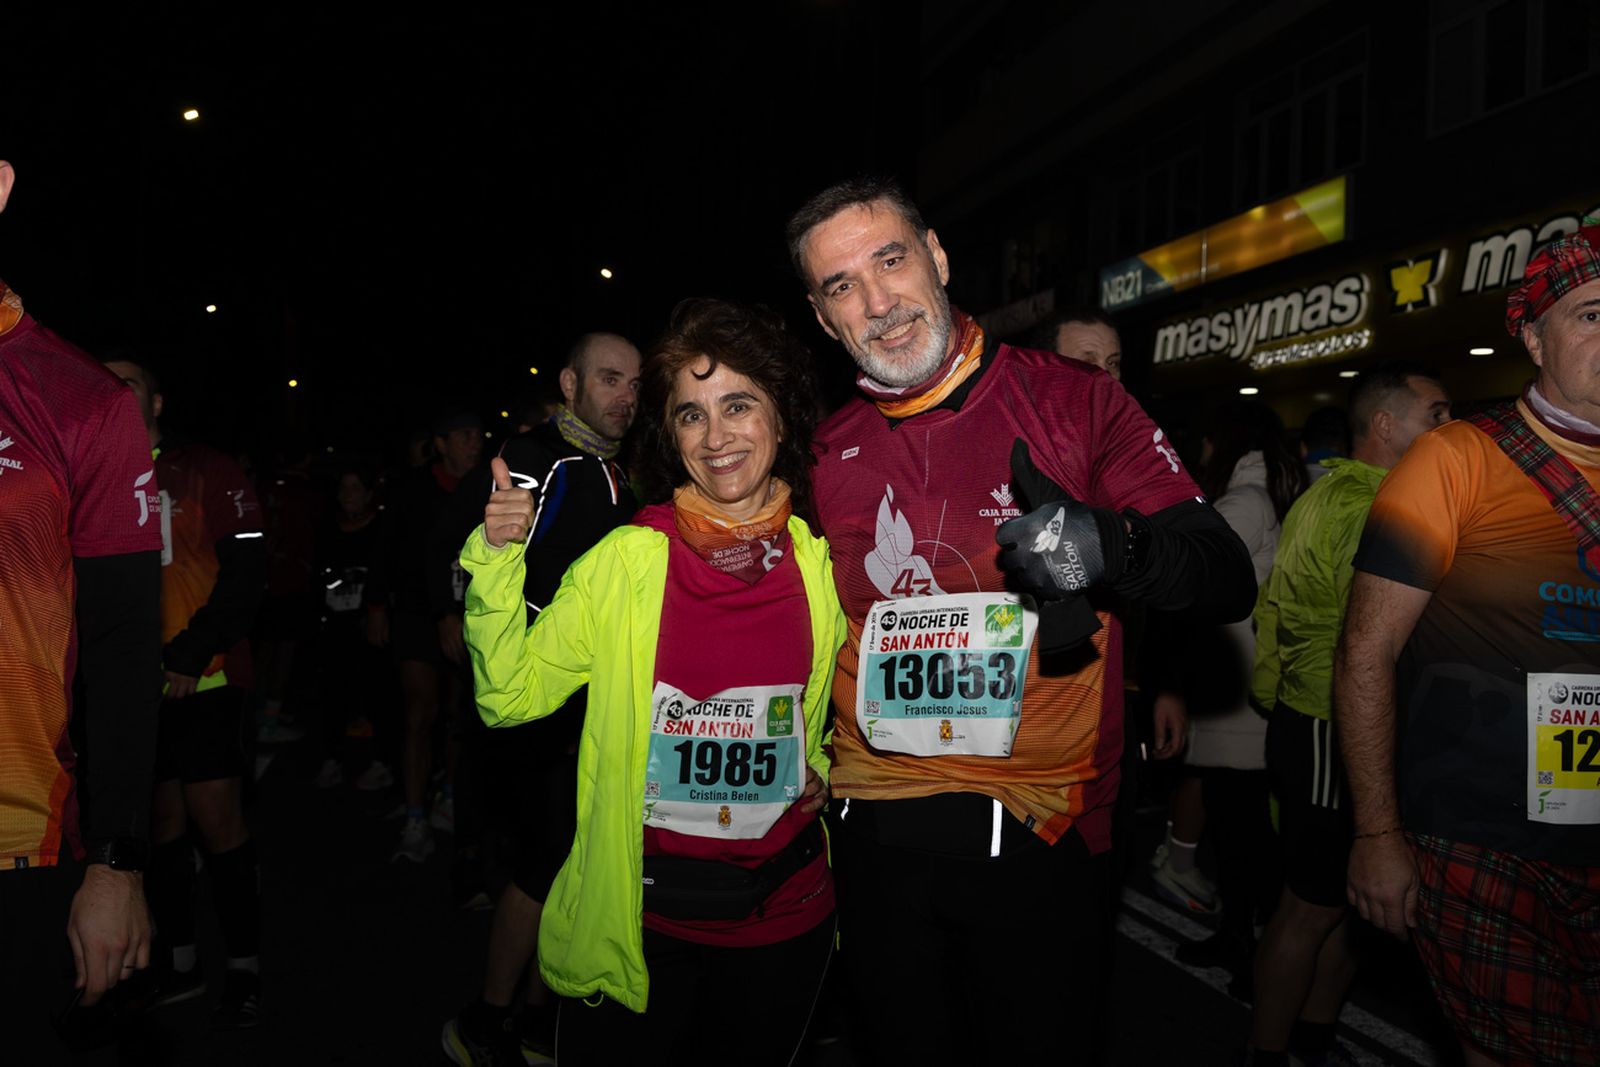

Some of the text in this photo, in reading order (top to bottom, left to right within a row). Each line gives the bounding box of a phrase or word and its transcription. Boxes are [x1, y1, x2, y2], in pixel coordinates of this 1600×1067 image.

[1102, 269, 1143, 308] NB21
[1153, 274, 1367, 364] masymas
[979, 508, 1022, 517] CAJA RUR
[1050, 520, 1062, 537] 43
[712, 545, 750, 559] NOCHE DE
[891, 569, 933, 598] 43
[1061, 563, 1080, 591] SAN
[1539, 581, 1600, 607] COM
[881, 616, 896, 626] 43
[898, 612, 969, 631] NOCHE DE
[880, 634, 910, 652] SAN
[913, 628, 969, 649] ANTÓN
[879, 652, 1016, 701] 13053
[670, 704, 681, 717] 43
[734, 704, 754, 718] DE
[905, 703, 988, 716] Francisco Jesus
[1550, 709, 1586, 725] SAN
[663, 718, 754, 739] SAN ANTÓN
[674, 739, 777, 787] 1985
[690, 789, 759, 801] Cristina Belen
